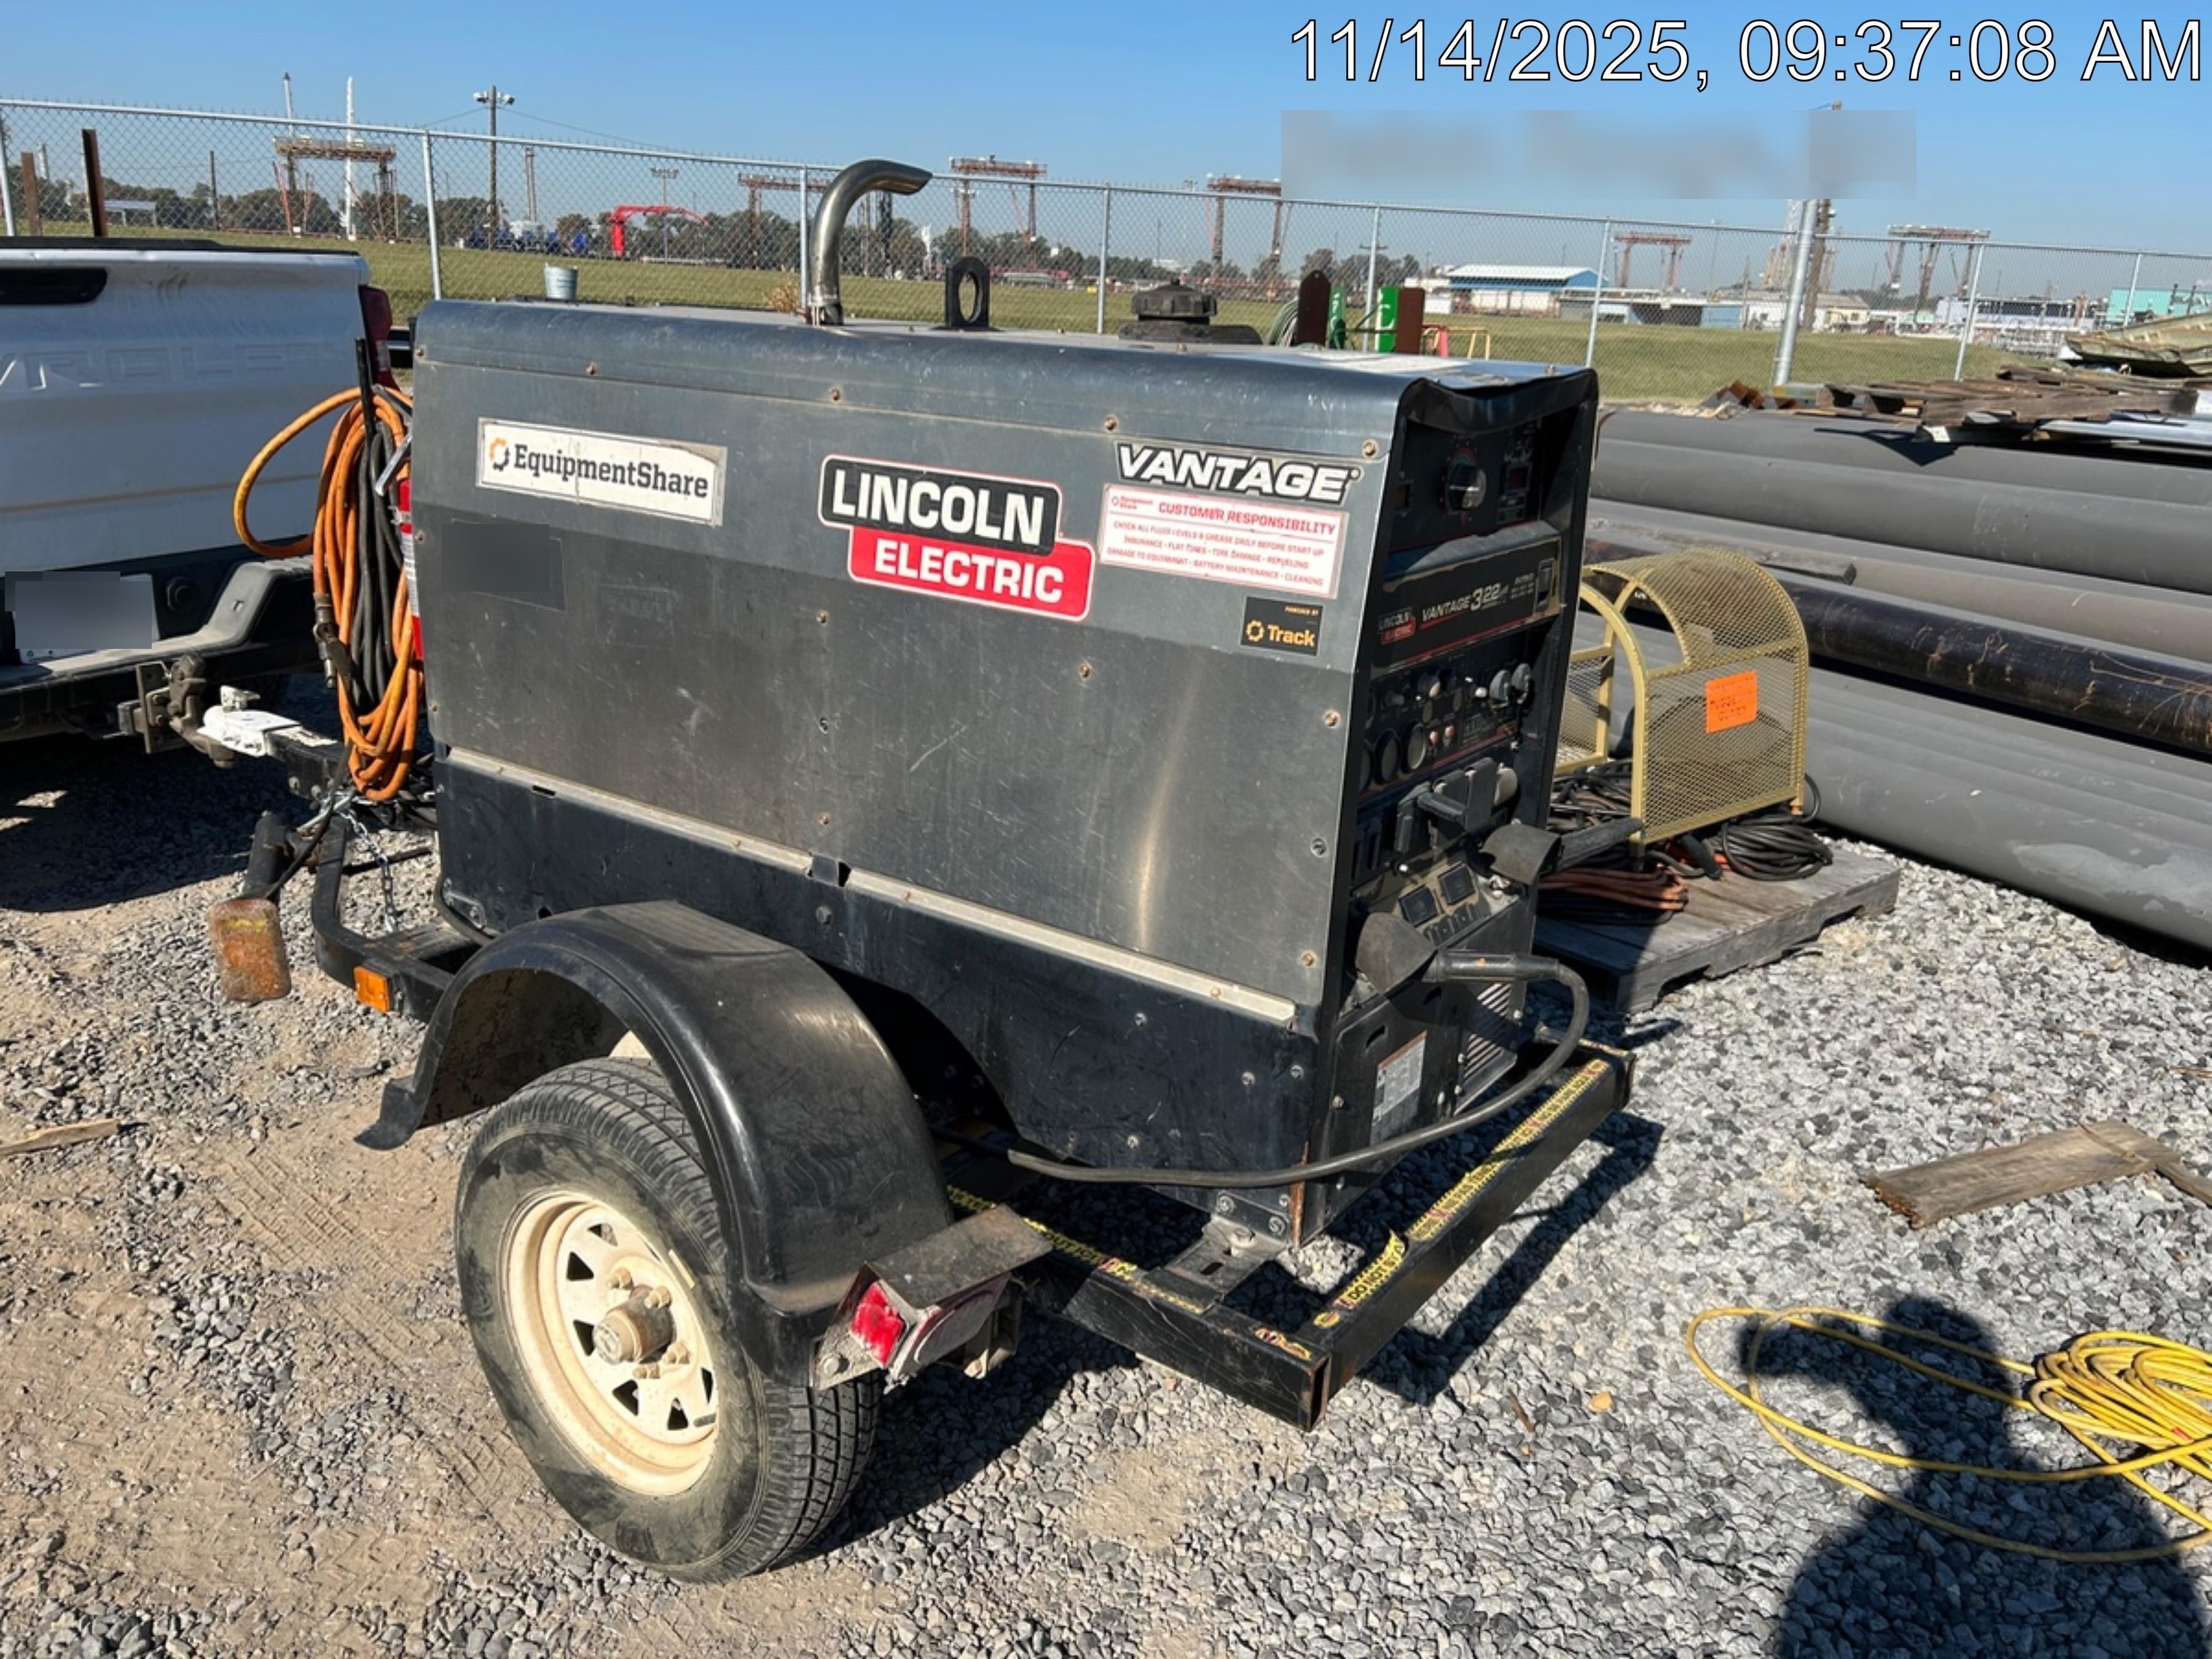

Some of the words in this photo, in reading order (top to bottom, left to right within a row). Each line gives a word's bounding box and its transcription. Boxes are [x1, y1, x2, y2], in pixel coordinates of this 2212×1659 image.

[514, 443, 709, 499] EquipmentShare
[1118, 443, 1349, 506] VANTAGE
[832, 469, 1045, 546] LINCOLN
[1159, 502, 1225, 521] CUSTOMER
[1227, 511, 1336, 535] RESPONSIBILITY
[1124, 535, 1162, 548] INSURANCE
[1168, 541, 1183, 551] FLAT
[1231, 549, 1261, 562] DAMAGE
[1288, 545, 1311, 555] START
[874, 538, 1064, 603] ELECTRIC
[1107, 547, 1135, 558] DAMAGE
[1193, 559, 1224, 571] BATTERY
[1225, 564, 1279, 579] MAINTENANCE
[1284, 573, 1324, 587] CLEANING
[1421, 595, 1471, 622] VANTAGE
[1268, 624, 1315, 648] Track
